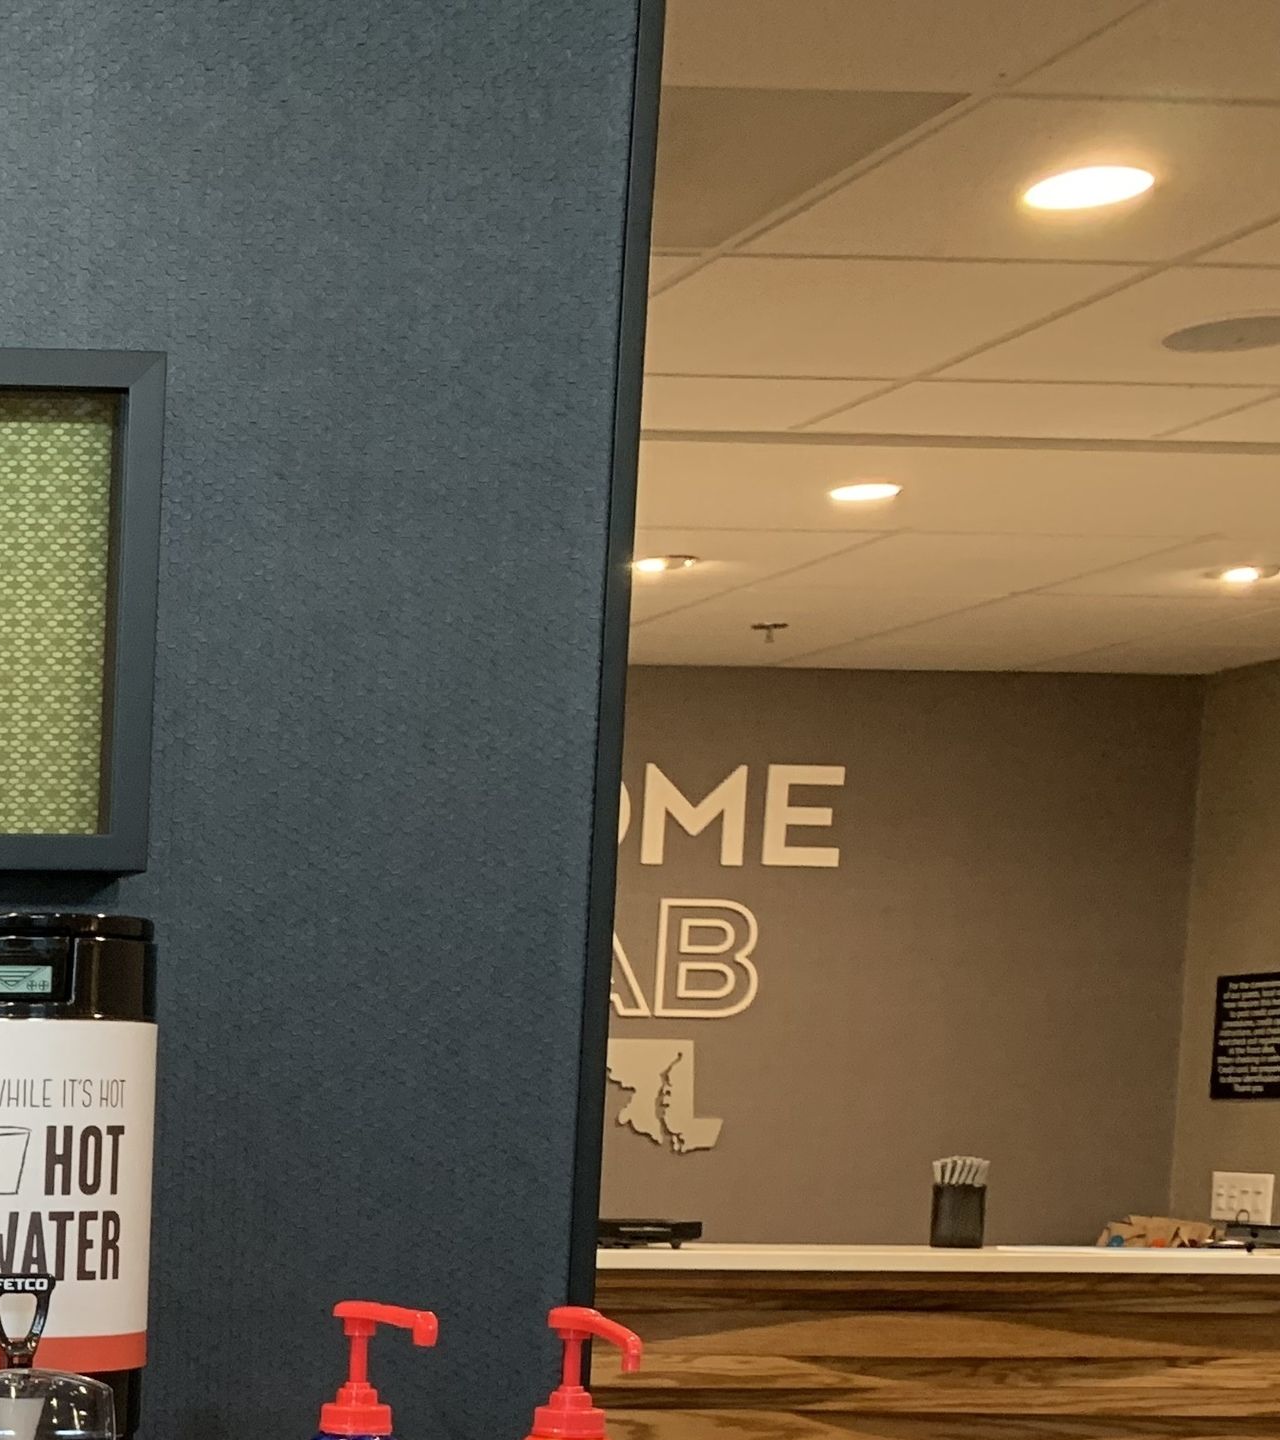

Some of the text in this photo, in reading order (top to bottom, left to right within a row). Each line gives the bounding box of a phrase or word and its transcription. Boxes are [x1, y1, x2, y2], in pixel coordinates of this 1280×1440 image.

[618, 762, 846, 867] ME
[62, 1078, 93, 1108] IT'S
[99, 1079, 126, 1108] HOT
[44, 1125, 125, 1196] HOT
